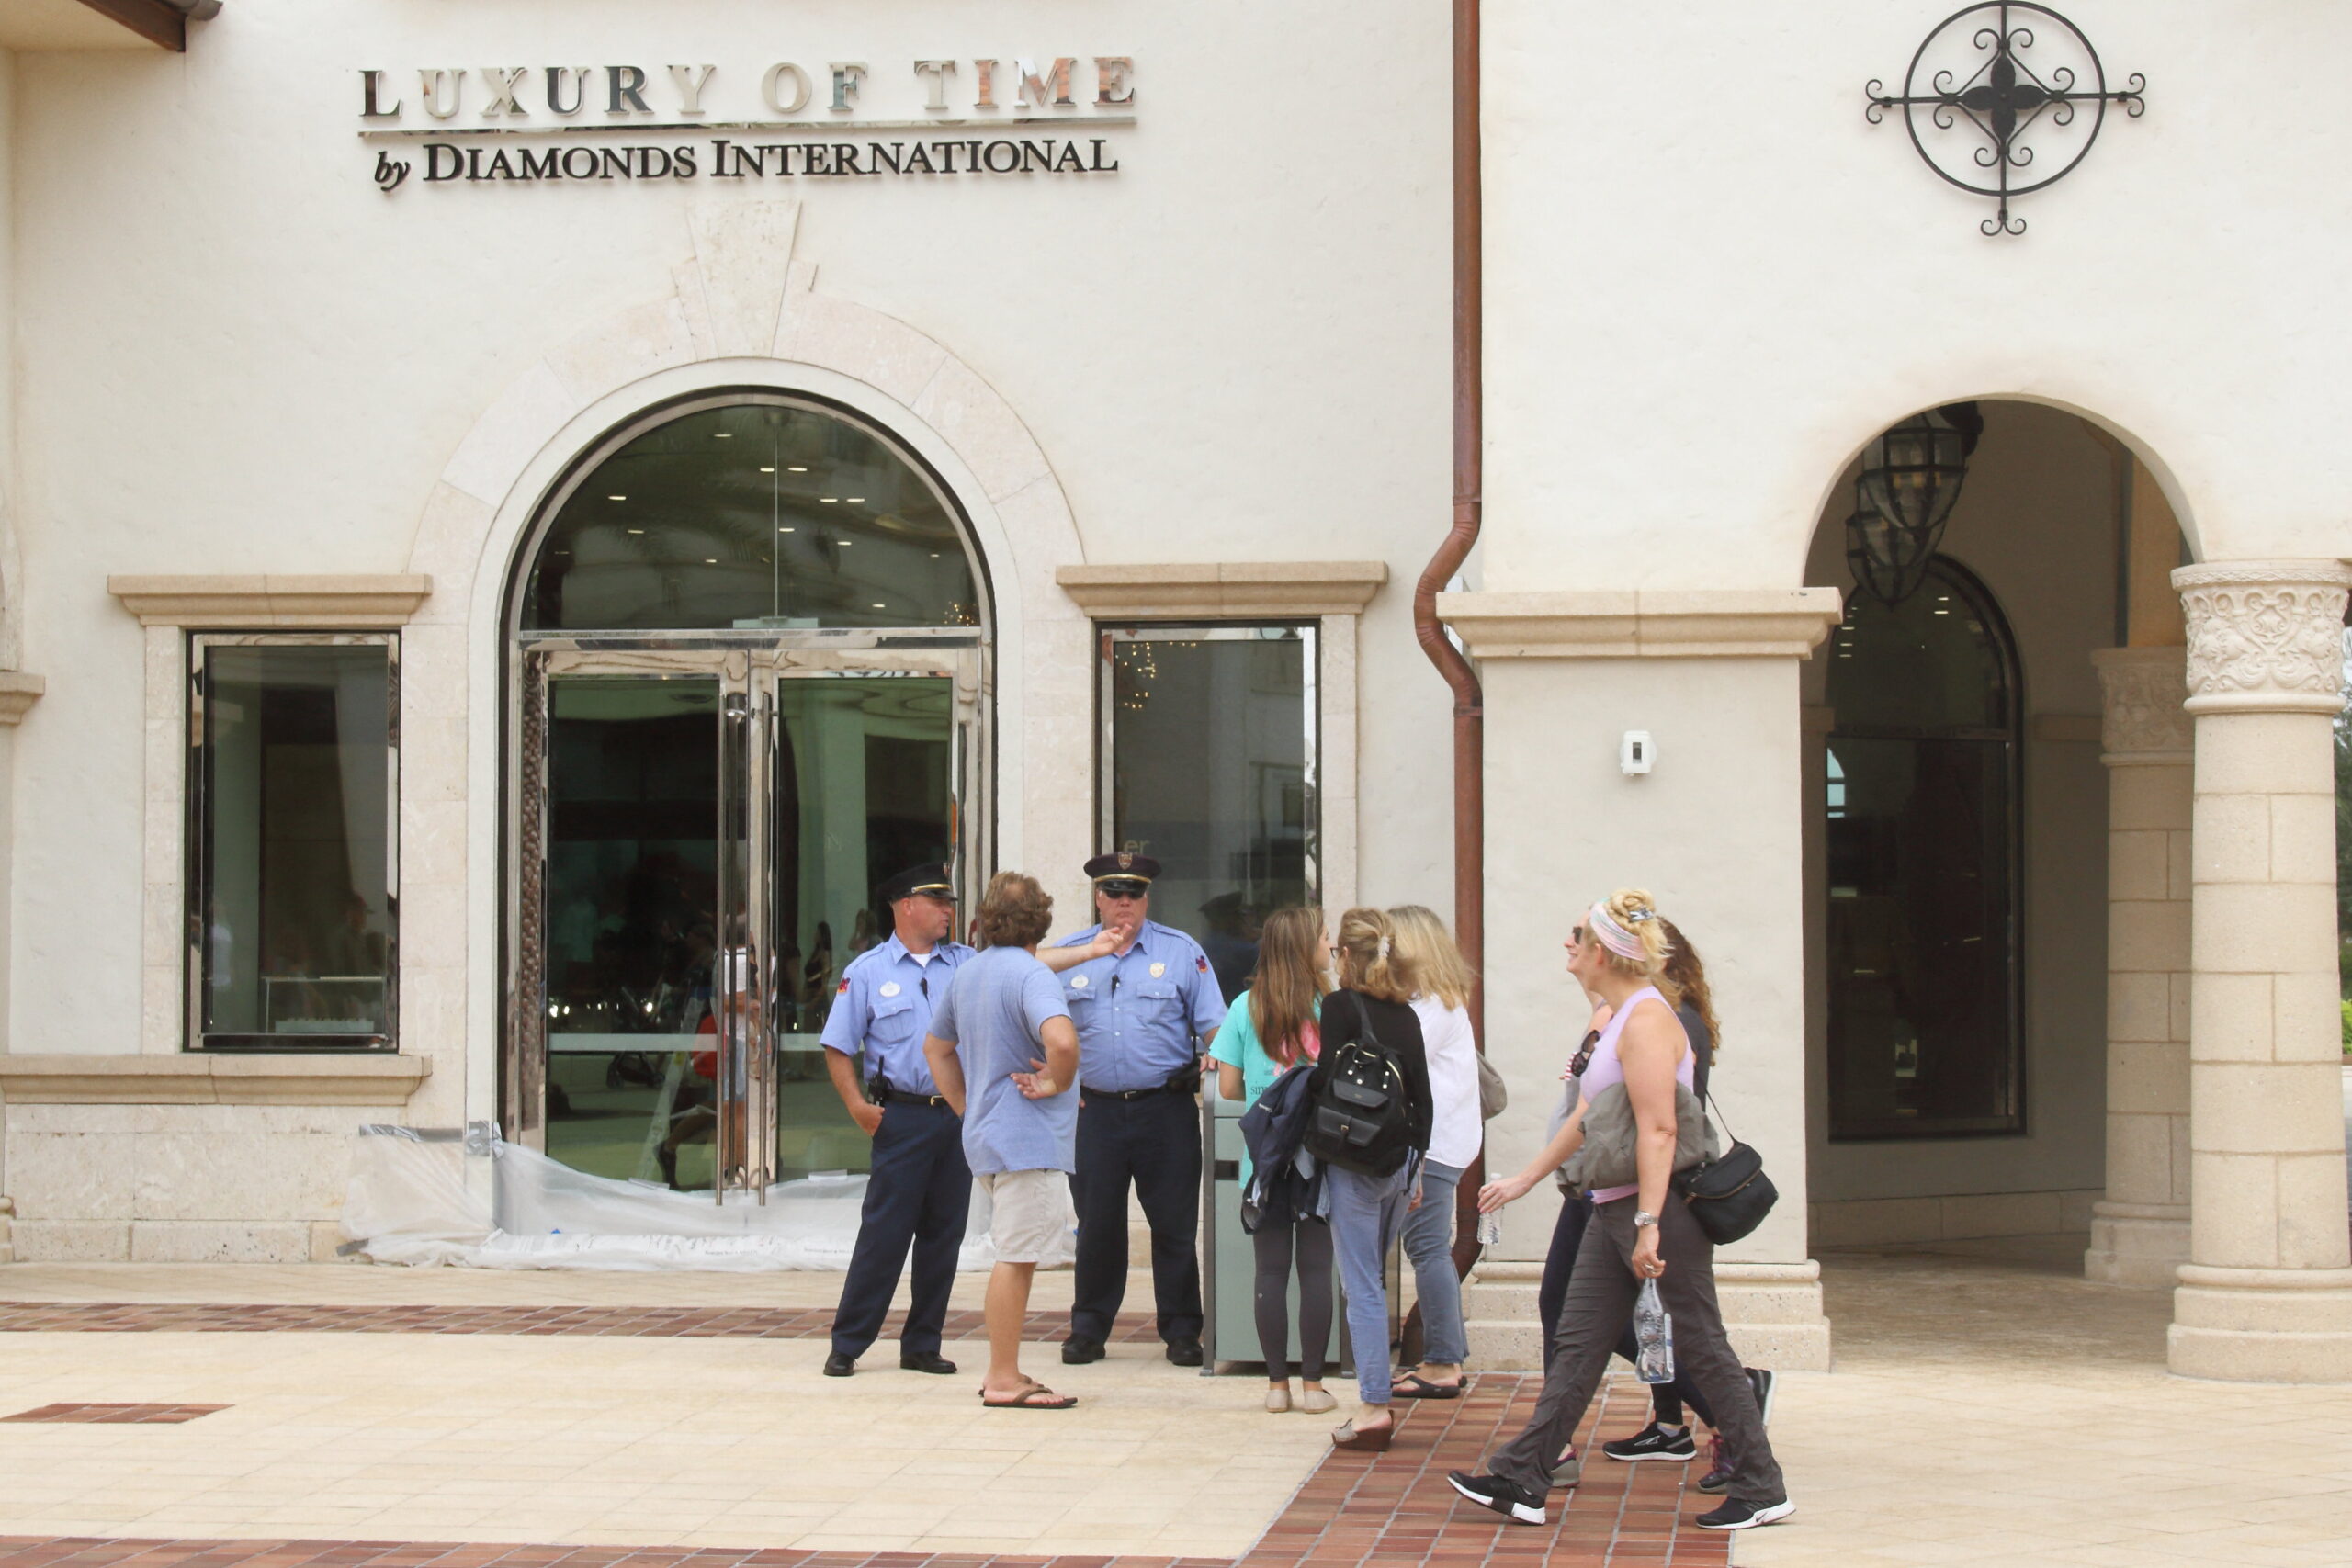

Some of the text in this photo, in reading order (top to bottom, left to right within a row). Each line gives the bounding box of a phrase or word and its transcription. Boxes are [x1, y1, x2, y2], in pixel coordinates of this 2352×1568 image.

[358, 56, 1136, 118] LUXURY OF TIME
[374, 139, 1119, 191] by DIAMONDS INTERNATIONAL
